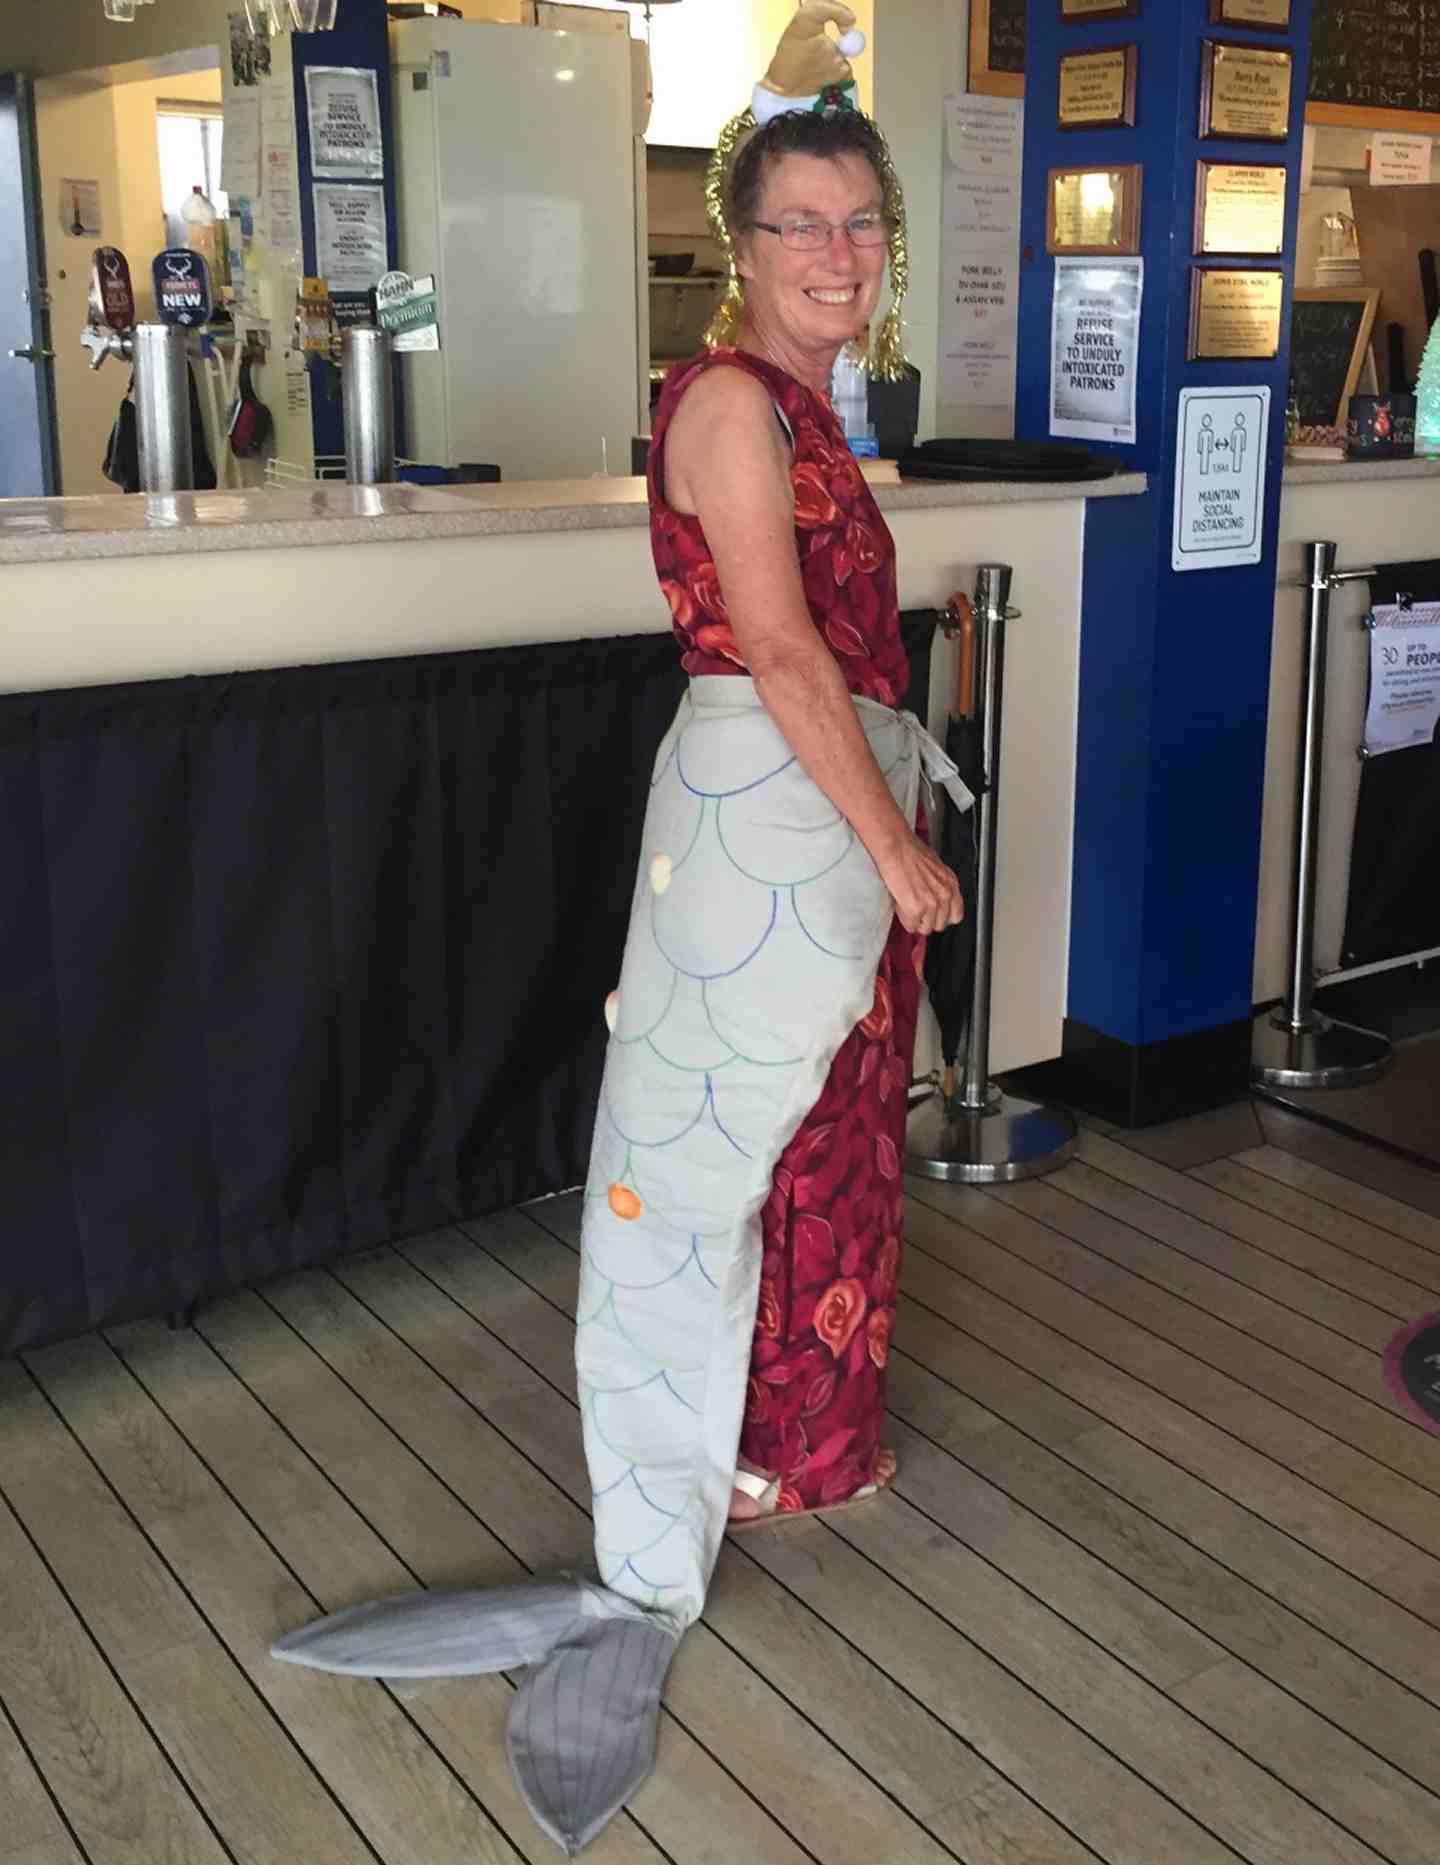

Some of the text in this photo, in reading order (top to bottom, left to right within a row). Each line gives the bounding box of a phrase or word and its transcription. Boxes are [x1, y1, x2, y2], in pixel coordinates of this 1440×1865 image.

[380, 279, 413, 299] HAHN
[162, 293, 200, 307] NEW
[1076, 317, 1113, 331] REFUSE
[1073, 332, 1114, 347] SERVICE
[1067, 347, 1122, 362] TO UNDULY
[1062, 360, 1125, 378] INTOXICATED
[1070, 376, 1116, 392] PATRONS
[1198, 489, 1241, 502] MAINTAIN
[1203, 503, 1234, 518] SOCIAL
[1192, 516, 1244, 533] DISTANCING
[1382, 646, 1399, 666] 30
